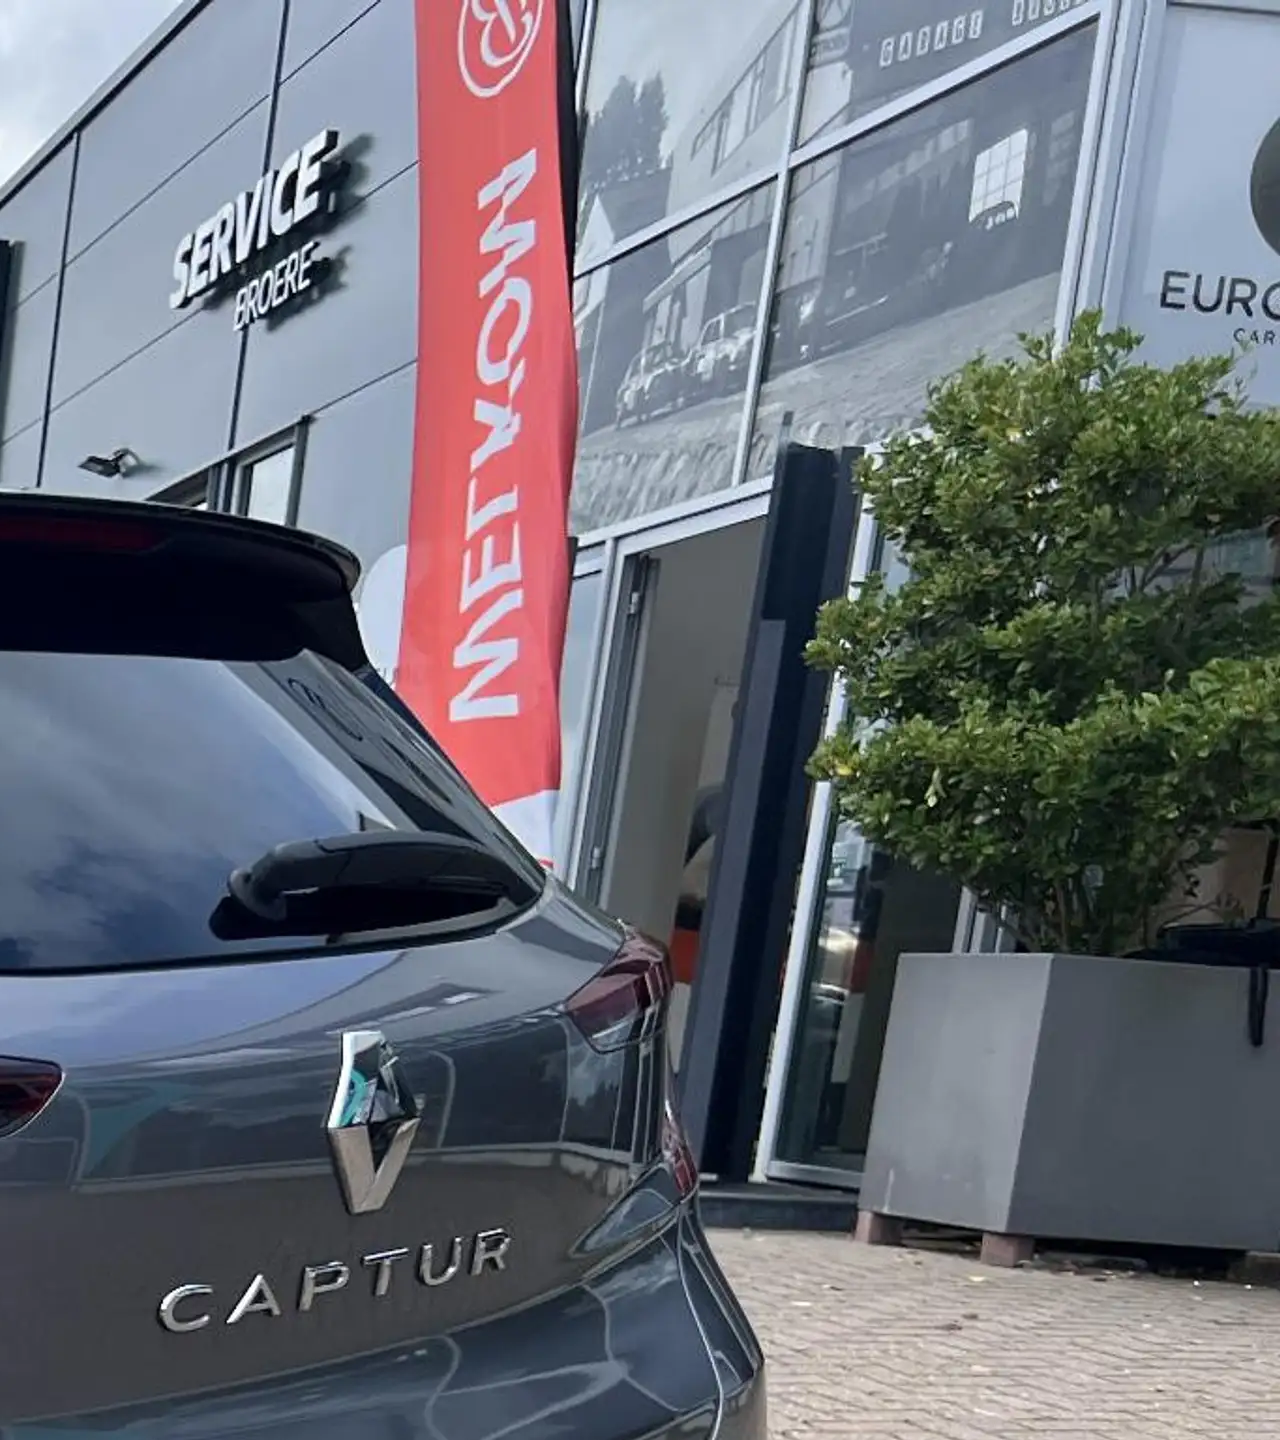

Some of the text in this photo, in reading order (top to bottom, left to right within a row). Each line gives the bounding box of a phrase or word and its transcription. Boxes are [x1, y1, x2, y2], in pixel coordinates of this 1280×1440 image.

[170, 128, 339, 309] SERVICE
[233, 241, 320, 331] BROERE
[1233, 328, 1276, 346] CAR
[158, 1228, 511, 1333] CAPTUR
